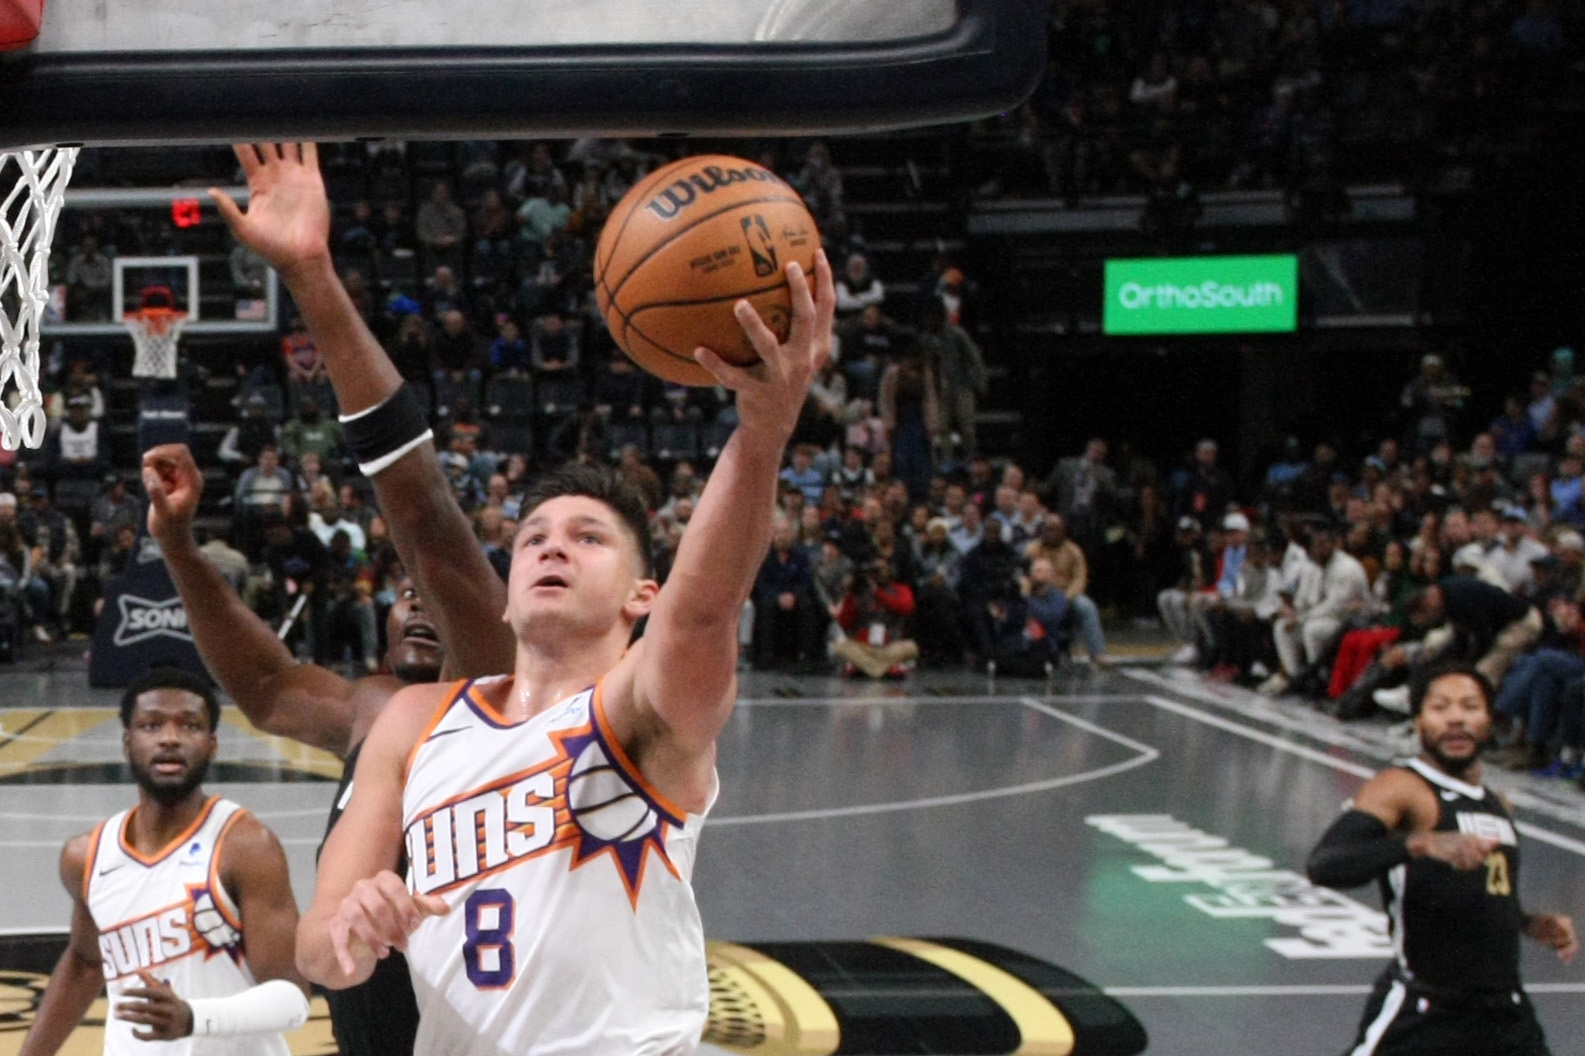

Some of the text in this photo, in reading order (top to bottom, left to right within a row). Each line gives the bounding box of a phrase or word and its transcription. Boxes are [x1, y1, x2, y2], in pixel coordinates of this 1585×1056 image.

[1119, 280, 1283, 309] OrthoSouth
[127, 608, 188, 630] SONI
[404, 771, 556, 896] UNS
[462, 887, 517, 991] 8
